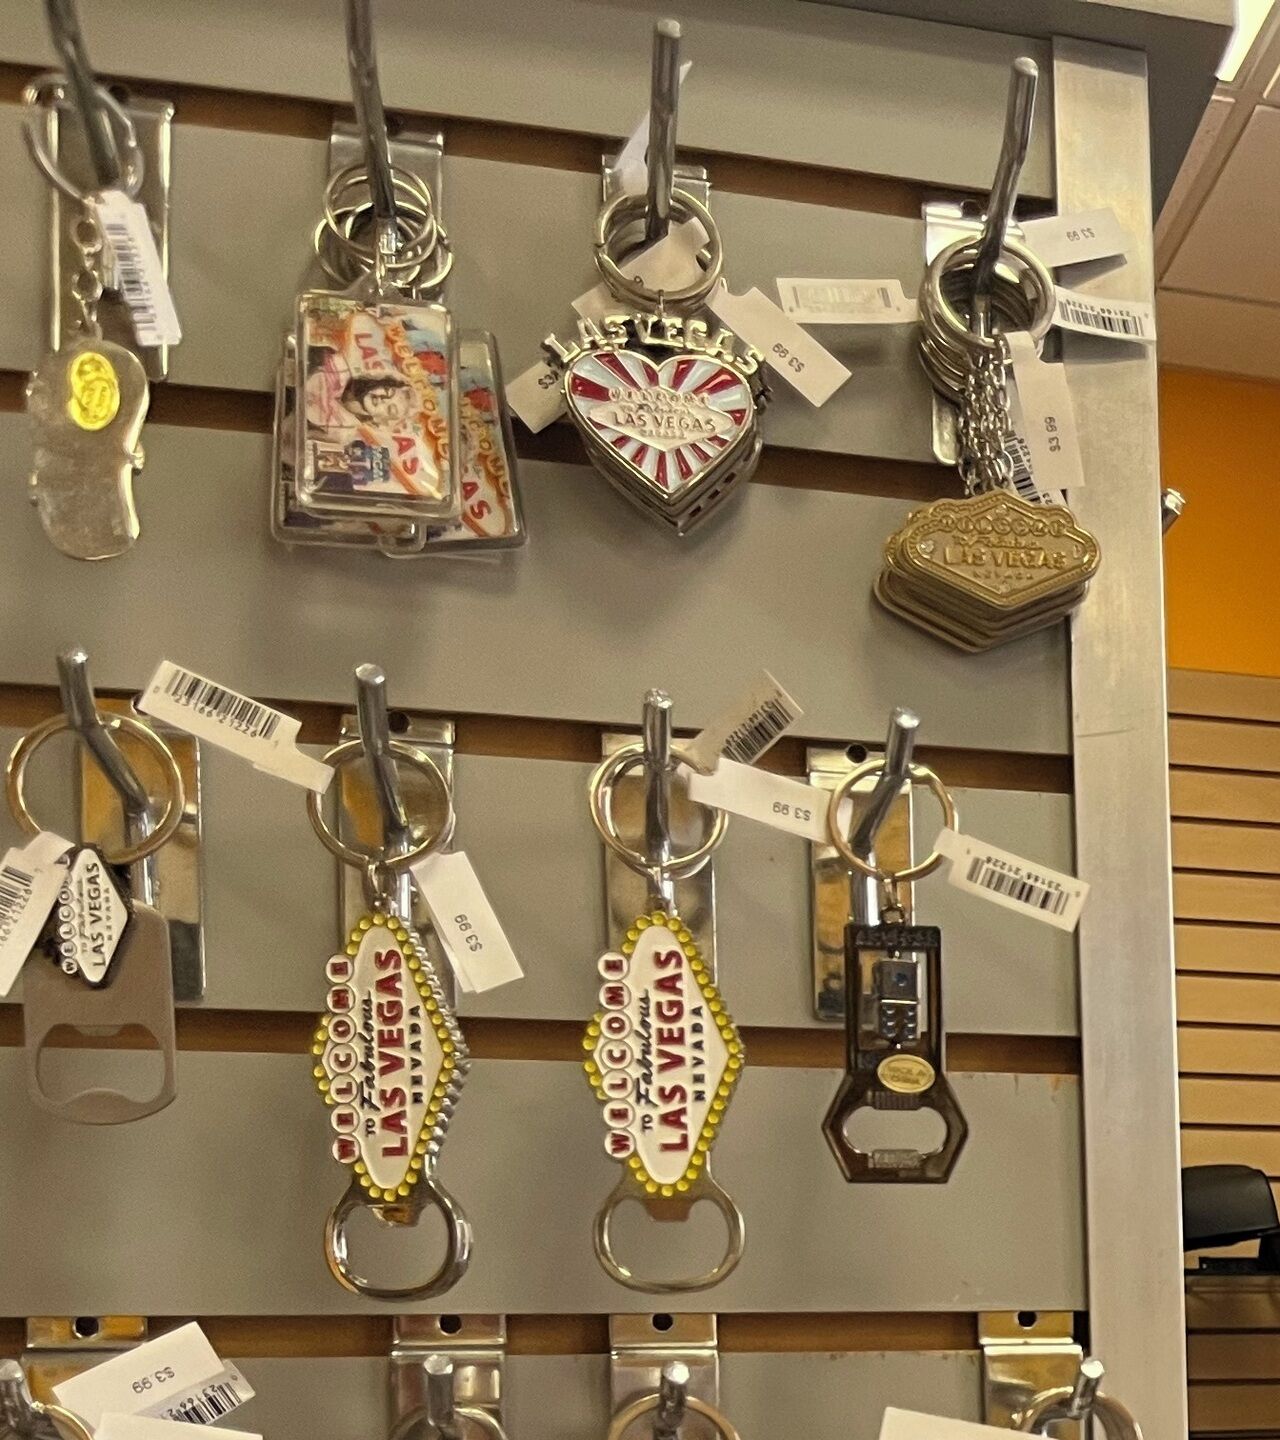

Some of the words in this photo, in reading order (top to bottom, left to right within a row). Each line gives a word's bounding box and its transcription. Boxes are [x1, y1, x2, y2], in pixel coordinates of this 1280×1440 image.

[634, 313, 764, 375] VEGAS
[614, 411, 648, 428] LAS
[655, 413, 716, 433] VEGAS
[944, 545, 986, 567] LAS
[990, 548, 1068, 570] VEGAS
[86, 862, 103, 925] VEGAS
[91, 931, 106, 967] LAS
[330, 960, 356, 1161] WELCOME
[358, 989, 381, 1112] Fabulous
[374, 949, 406, 1078] VEGAS
[409, 1004, 424, 1105] NEVADA
[604, 958, 631, 1155] WELCOME
[634, 988, 659, 1109] Fabulous
[653, 948, 687, 1074] VEGAS
[691, 1004, 706, 1103] NEVADA
[379, 1086, 409, 1158] LAS
[658, 1083, 690, 1153] LAS
